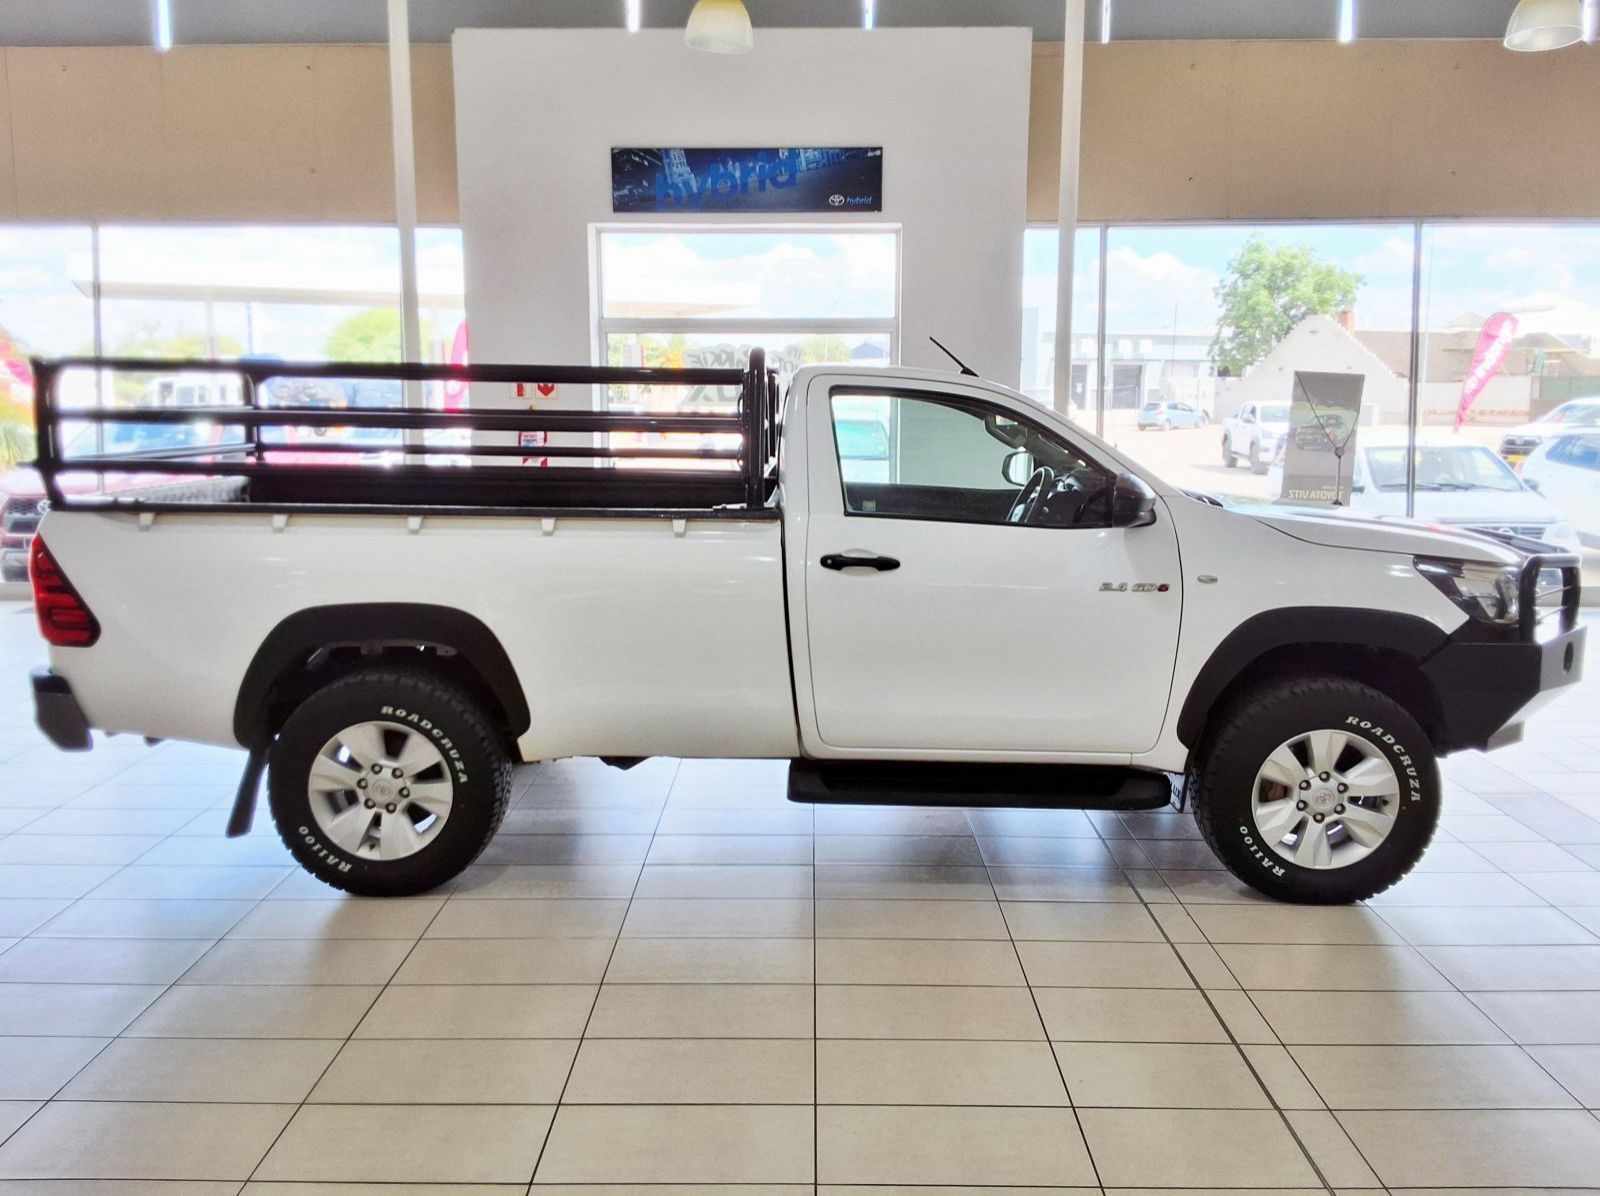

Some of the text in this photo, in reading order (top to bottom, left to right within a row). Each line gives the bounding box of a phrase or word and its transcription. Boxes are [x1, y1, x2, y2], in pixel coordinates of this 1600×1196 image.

[846, 194, 872, 206] hybrid
[381, 705, 468, 783] ROADCRUZA
[1345, 715, 1421, 801] ROADCRUZA
